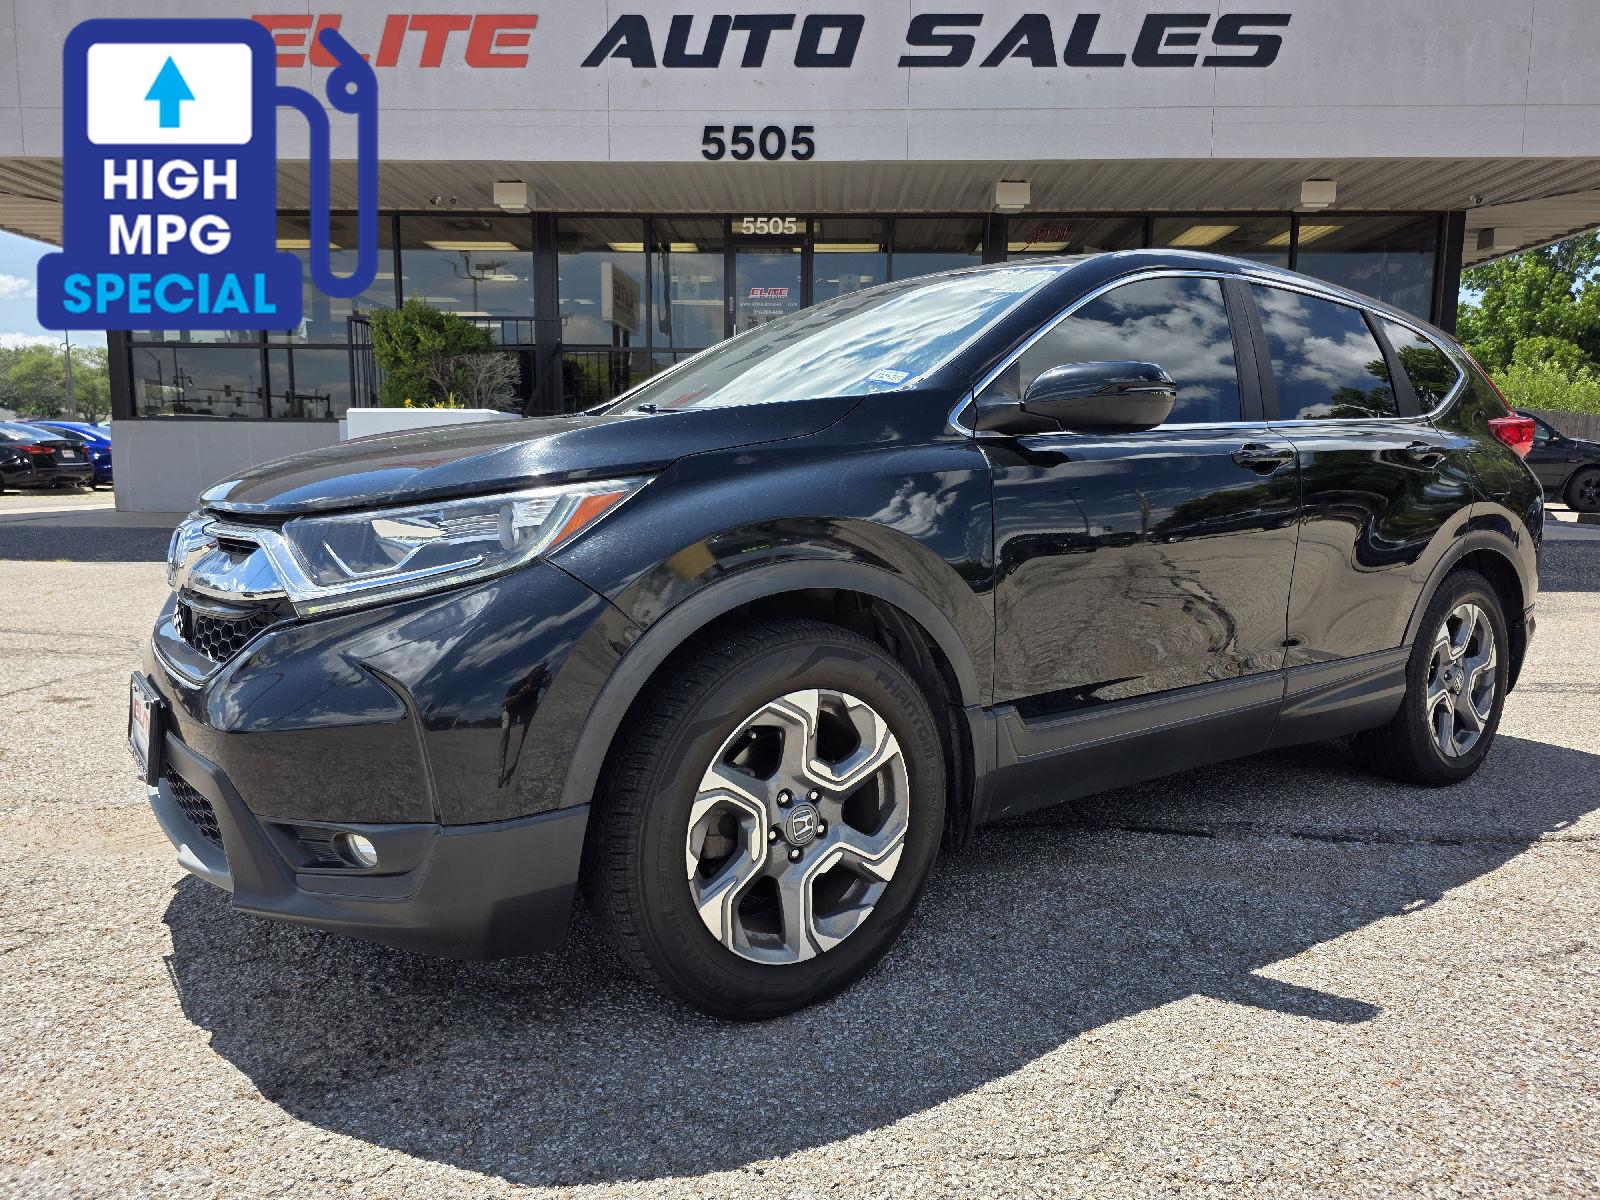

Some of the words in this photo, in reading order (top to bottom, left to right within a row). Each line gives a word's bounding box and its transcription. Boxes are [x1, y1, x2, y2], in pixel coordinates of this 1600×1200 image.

[252, 14, 539, 68] ELITE
[580, 14, 866, 68] AUTO
[898, 13, 1292, 68] SALES
[702, 125, 816, 162] 5505
[741, 217, 797, 235] 5505
[750, 287, 789, 297] ELITE
